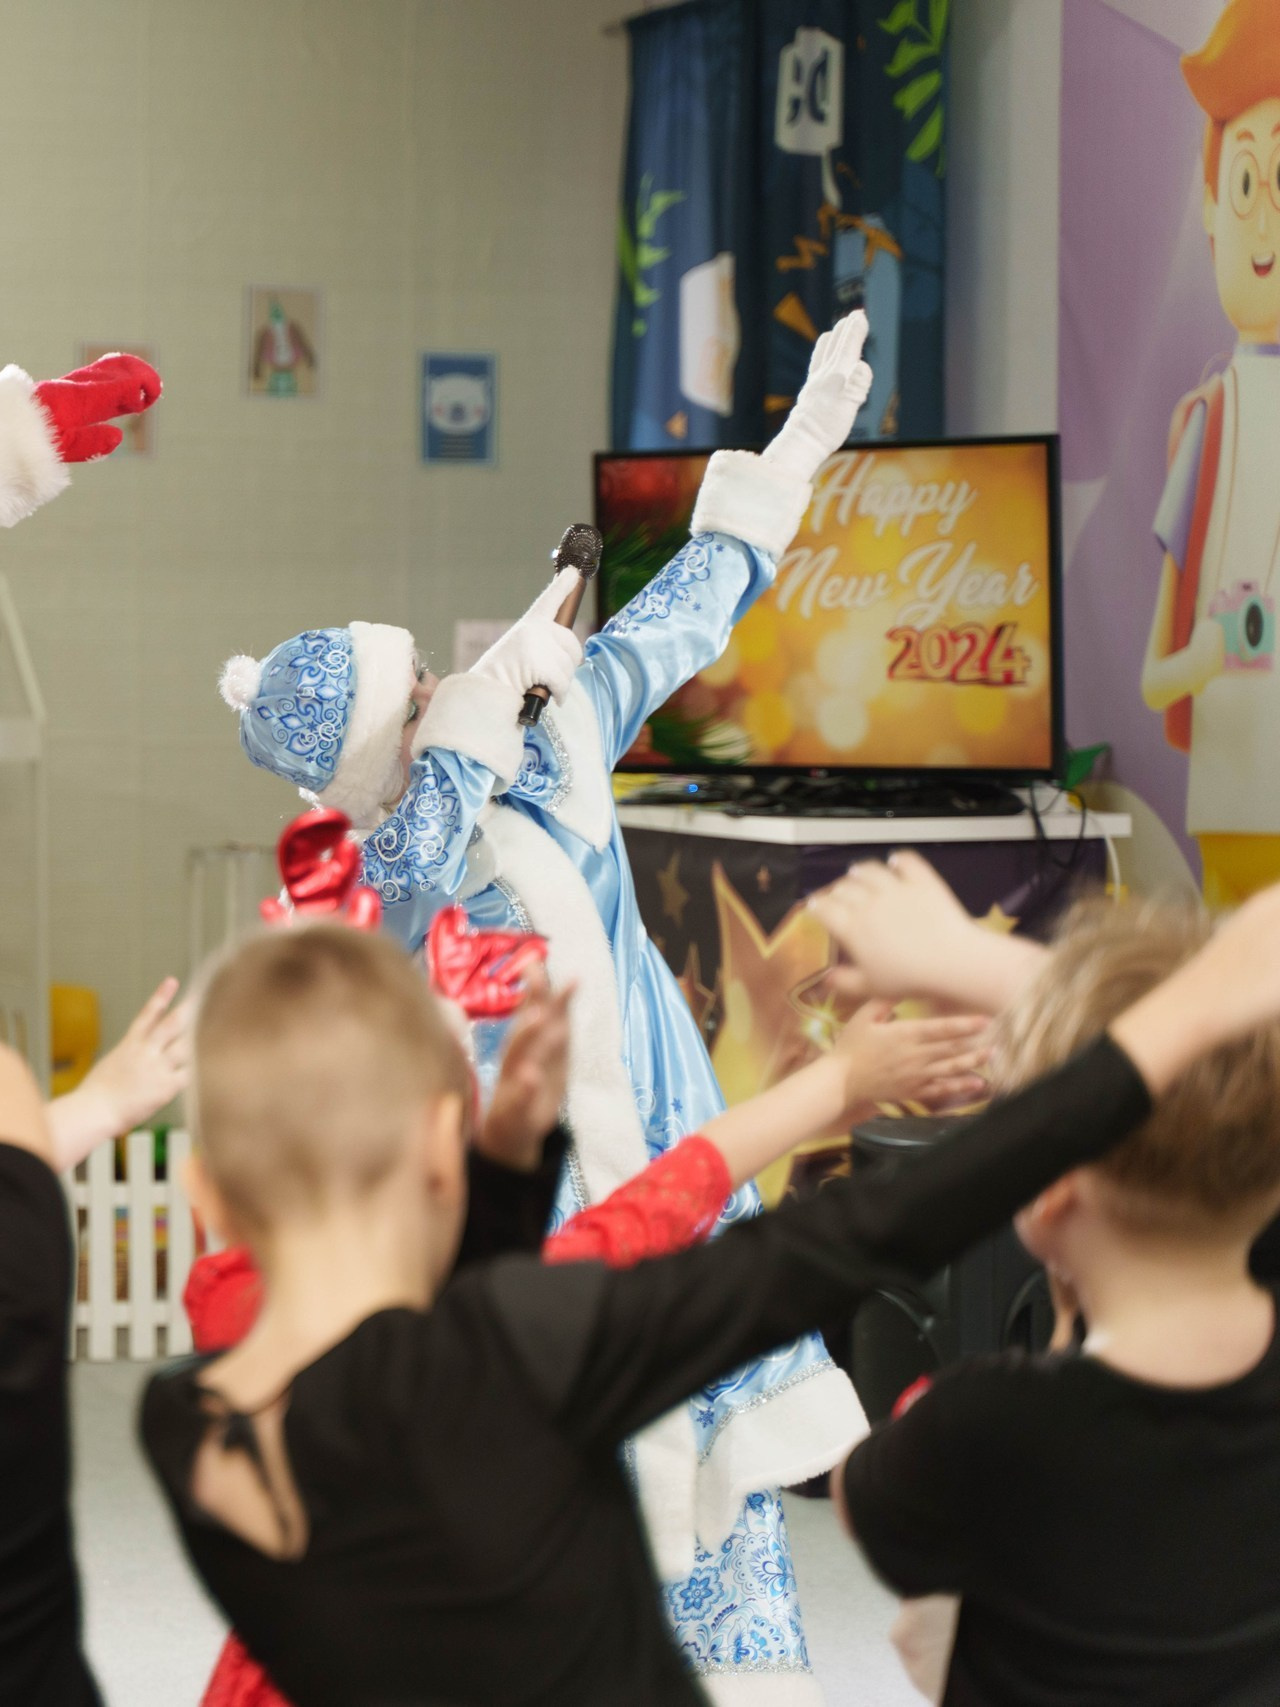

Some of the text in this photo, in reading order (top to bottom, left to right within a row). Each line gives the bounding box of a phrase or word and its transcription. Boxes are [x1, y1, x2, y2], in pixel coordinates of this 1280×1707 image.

[809, 451, 979, 538] Happy
[776, 540, 1039, 631] New Year
[885, 622, 1032, 686] 2024
